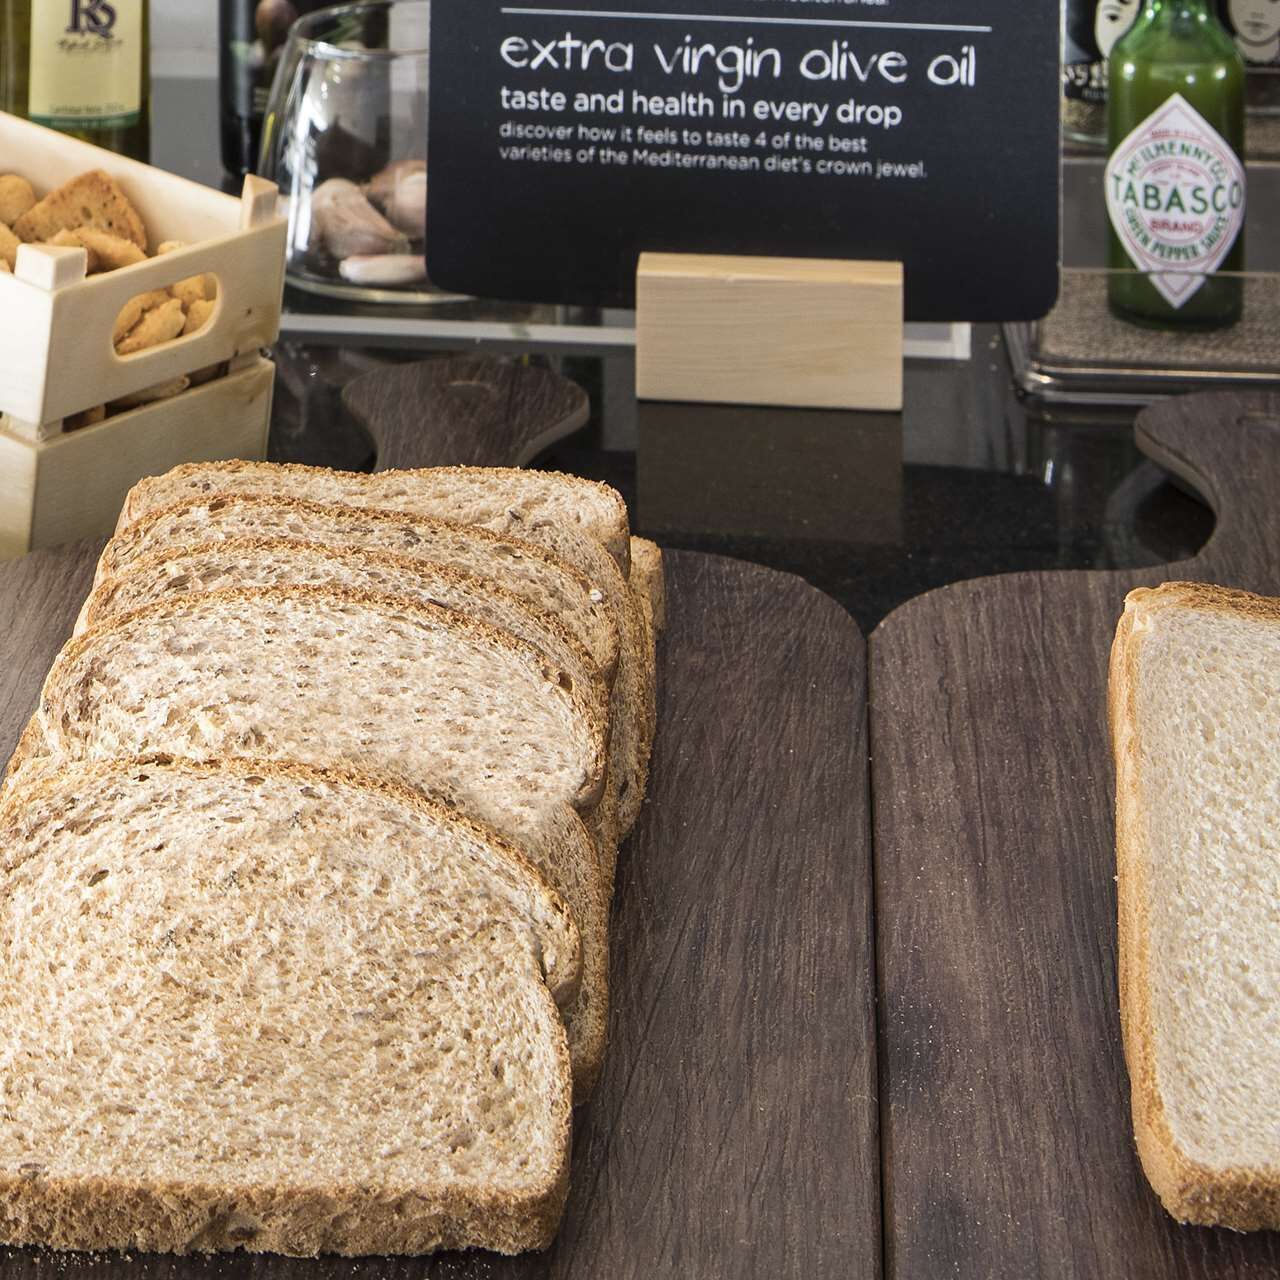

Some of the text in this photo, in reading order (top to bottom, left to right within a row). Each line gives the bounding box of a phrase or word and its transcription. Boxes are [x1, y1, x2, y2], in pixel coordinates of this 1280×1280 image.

[500, 31, 976, 93] extra virgin olive oil
[500, 86, 902, 129] taste and health in every drop
[499, 121, 868, 153] discover how it feels to taste 4 of the best
[499, 144, 928, 180] varieties of the Mediterranean diet's crown jewel.
[1111, 173, 1241, 216] TABASCO
[1149, 220, 1203, 234] BRAND
